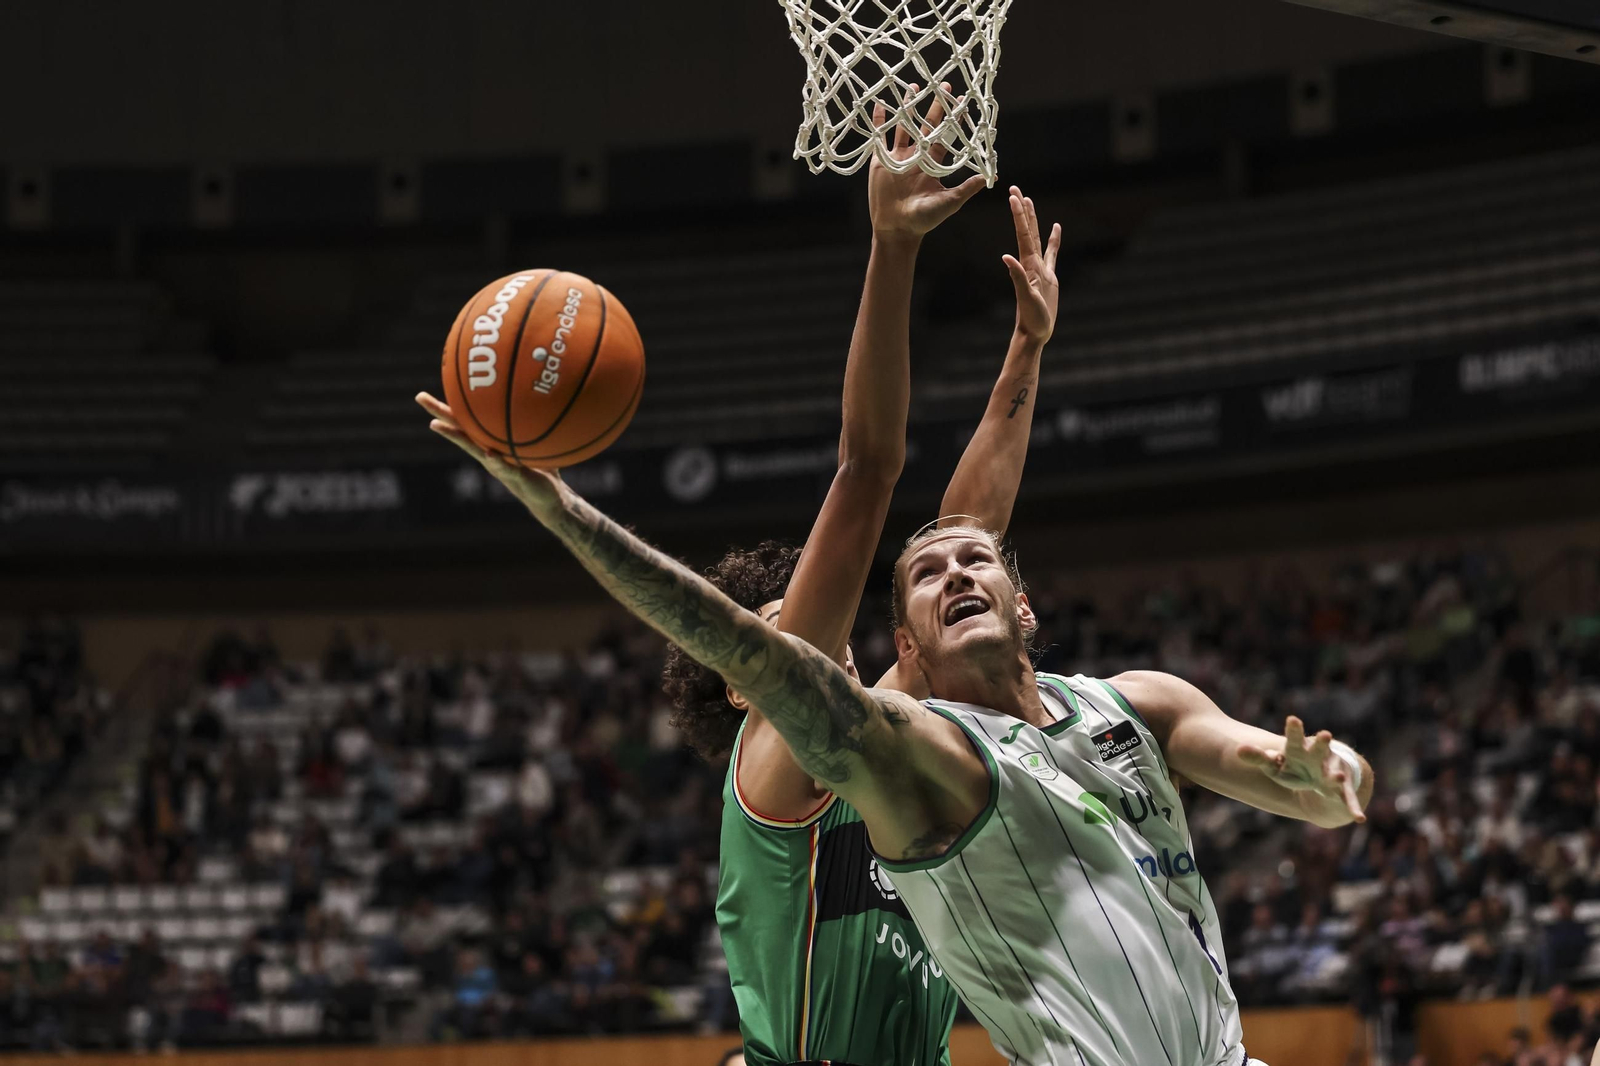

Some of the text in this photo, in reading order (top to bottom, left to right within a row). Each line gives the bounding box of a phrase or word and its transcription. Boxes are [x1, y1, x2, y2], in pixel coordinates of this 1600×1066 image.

[468, 275, 535, 391] Wilson
[533, 288, 583, 394] liga endesa
[1095, 739, 1115, 752] liga
[1101, 736, 1139, 758] endesa
